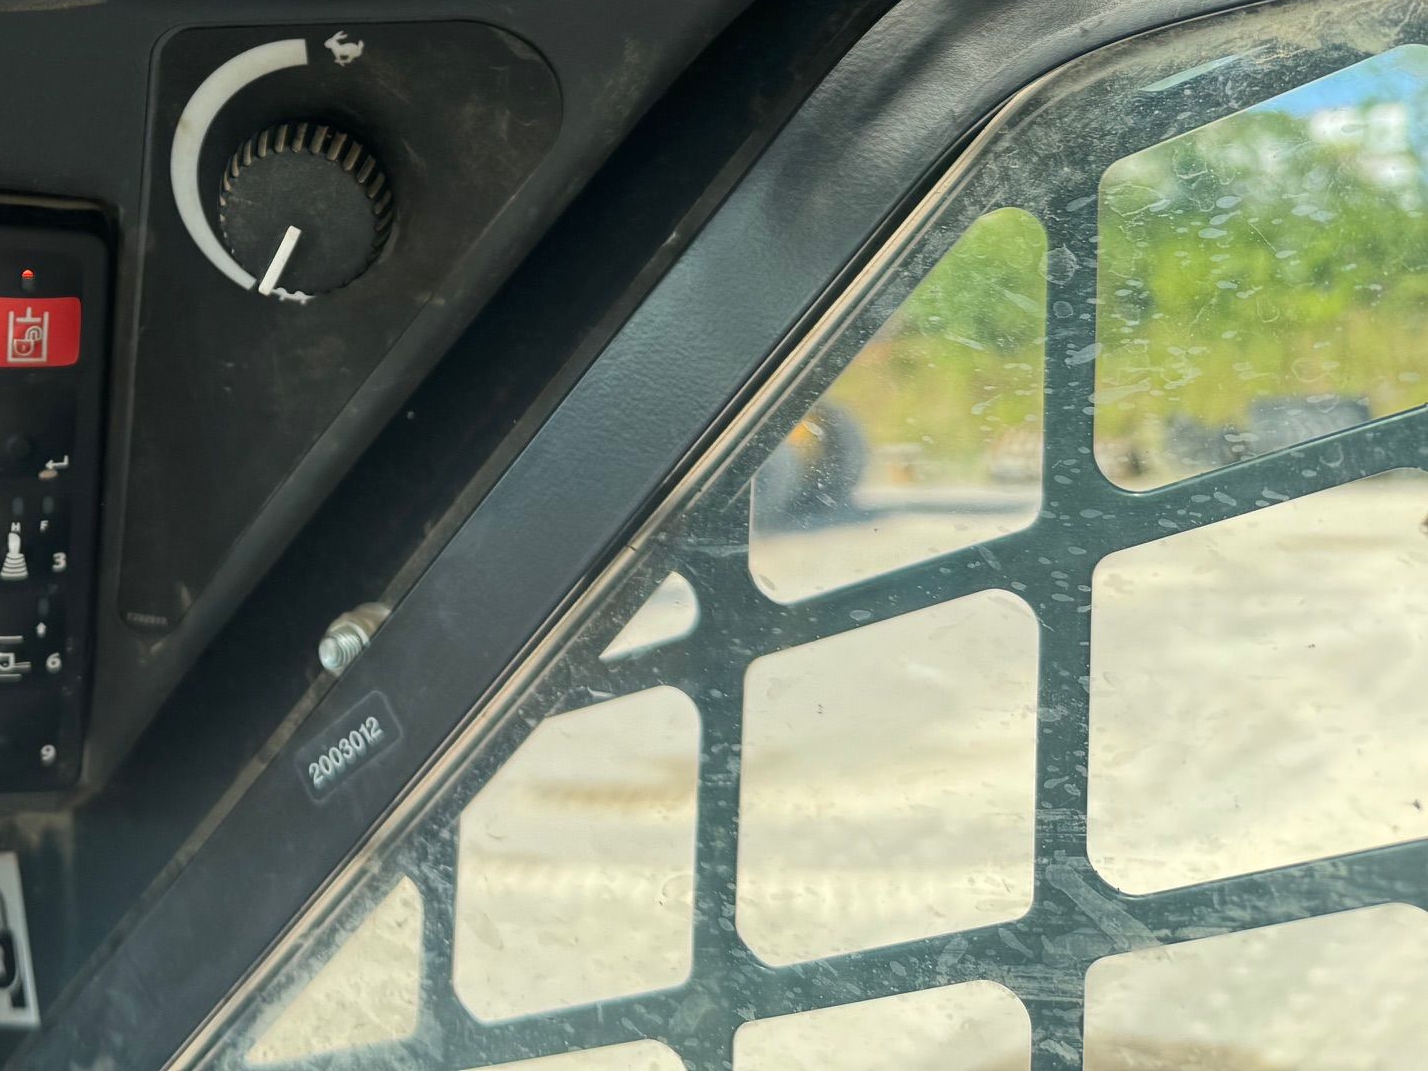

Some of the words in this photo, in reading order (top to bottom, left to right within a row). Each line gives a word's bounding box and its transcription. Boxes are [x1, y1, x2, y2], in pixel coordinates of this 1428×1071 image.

[11, 521, 21, 533] H
[52, 552, 67, 572] 3
[46, 652, 61, 672] 6
[40, 744, 56, 765] 9
[308, 716, 383, 788] 2003012
